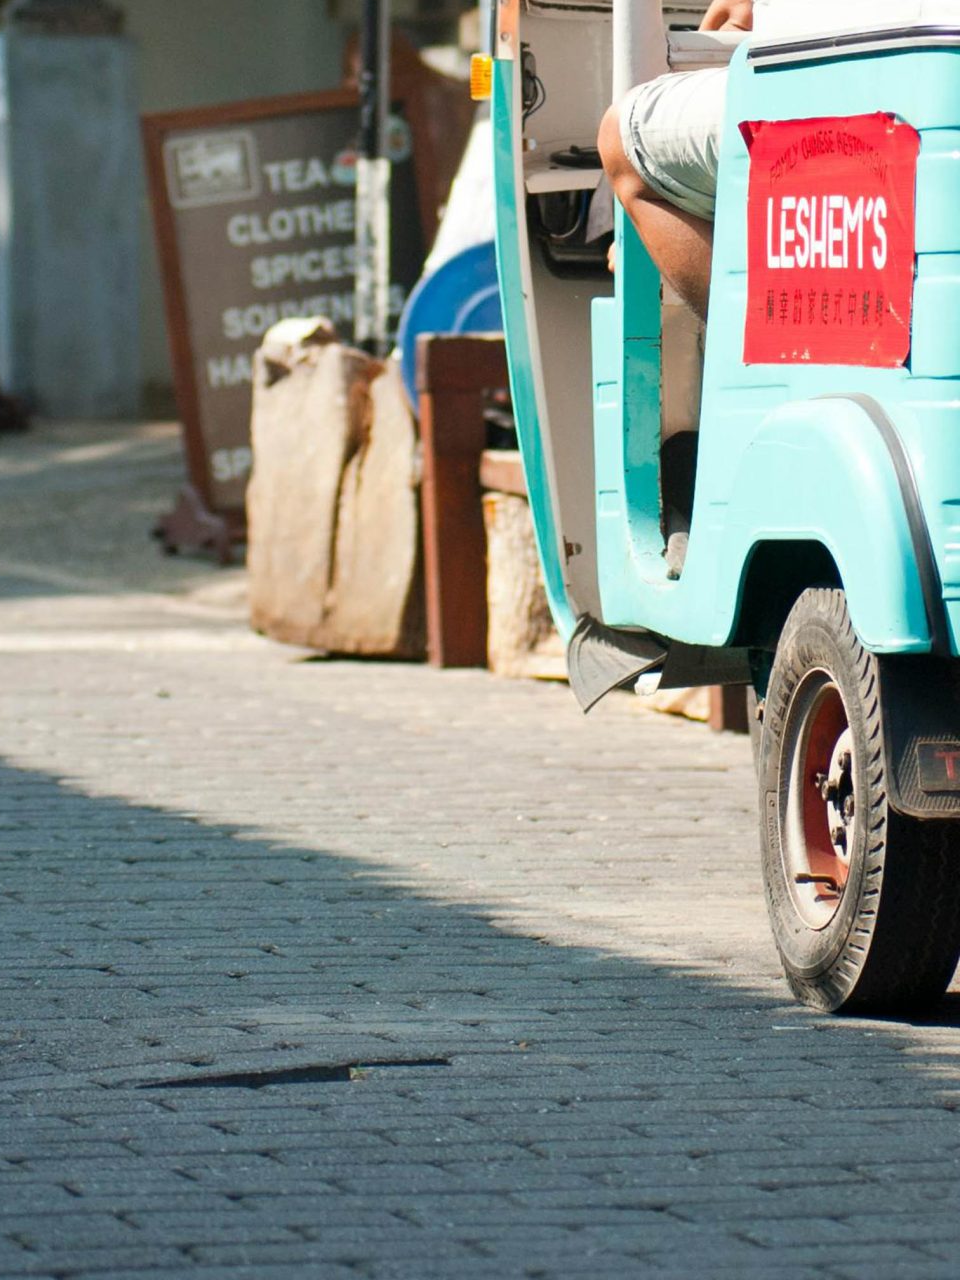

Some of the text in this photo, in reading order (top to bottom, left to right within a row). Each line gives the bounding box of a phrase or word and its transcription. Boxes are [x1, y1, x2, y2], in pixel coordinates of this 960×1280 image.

[263, 158, 330, 193] TEA
[228, 200, 356, 246] CLOTHE
[767, 195, 888, 270] LESHEM'S
